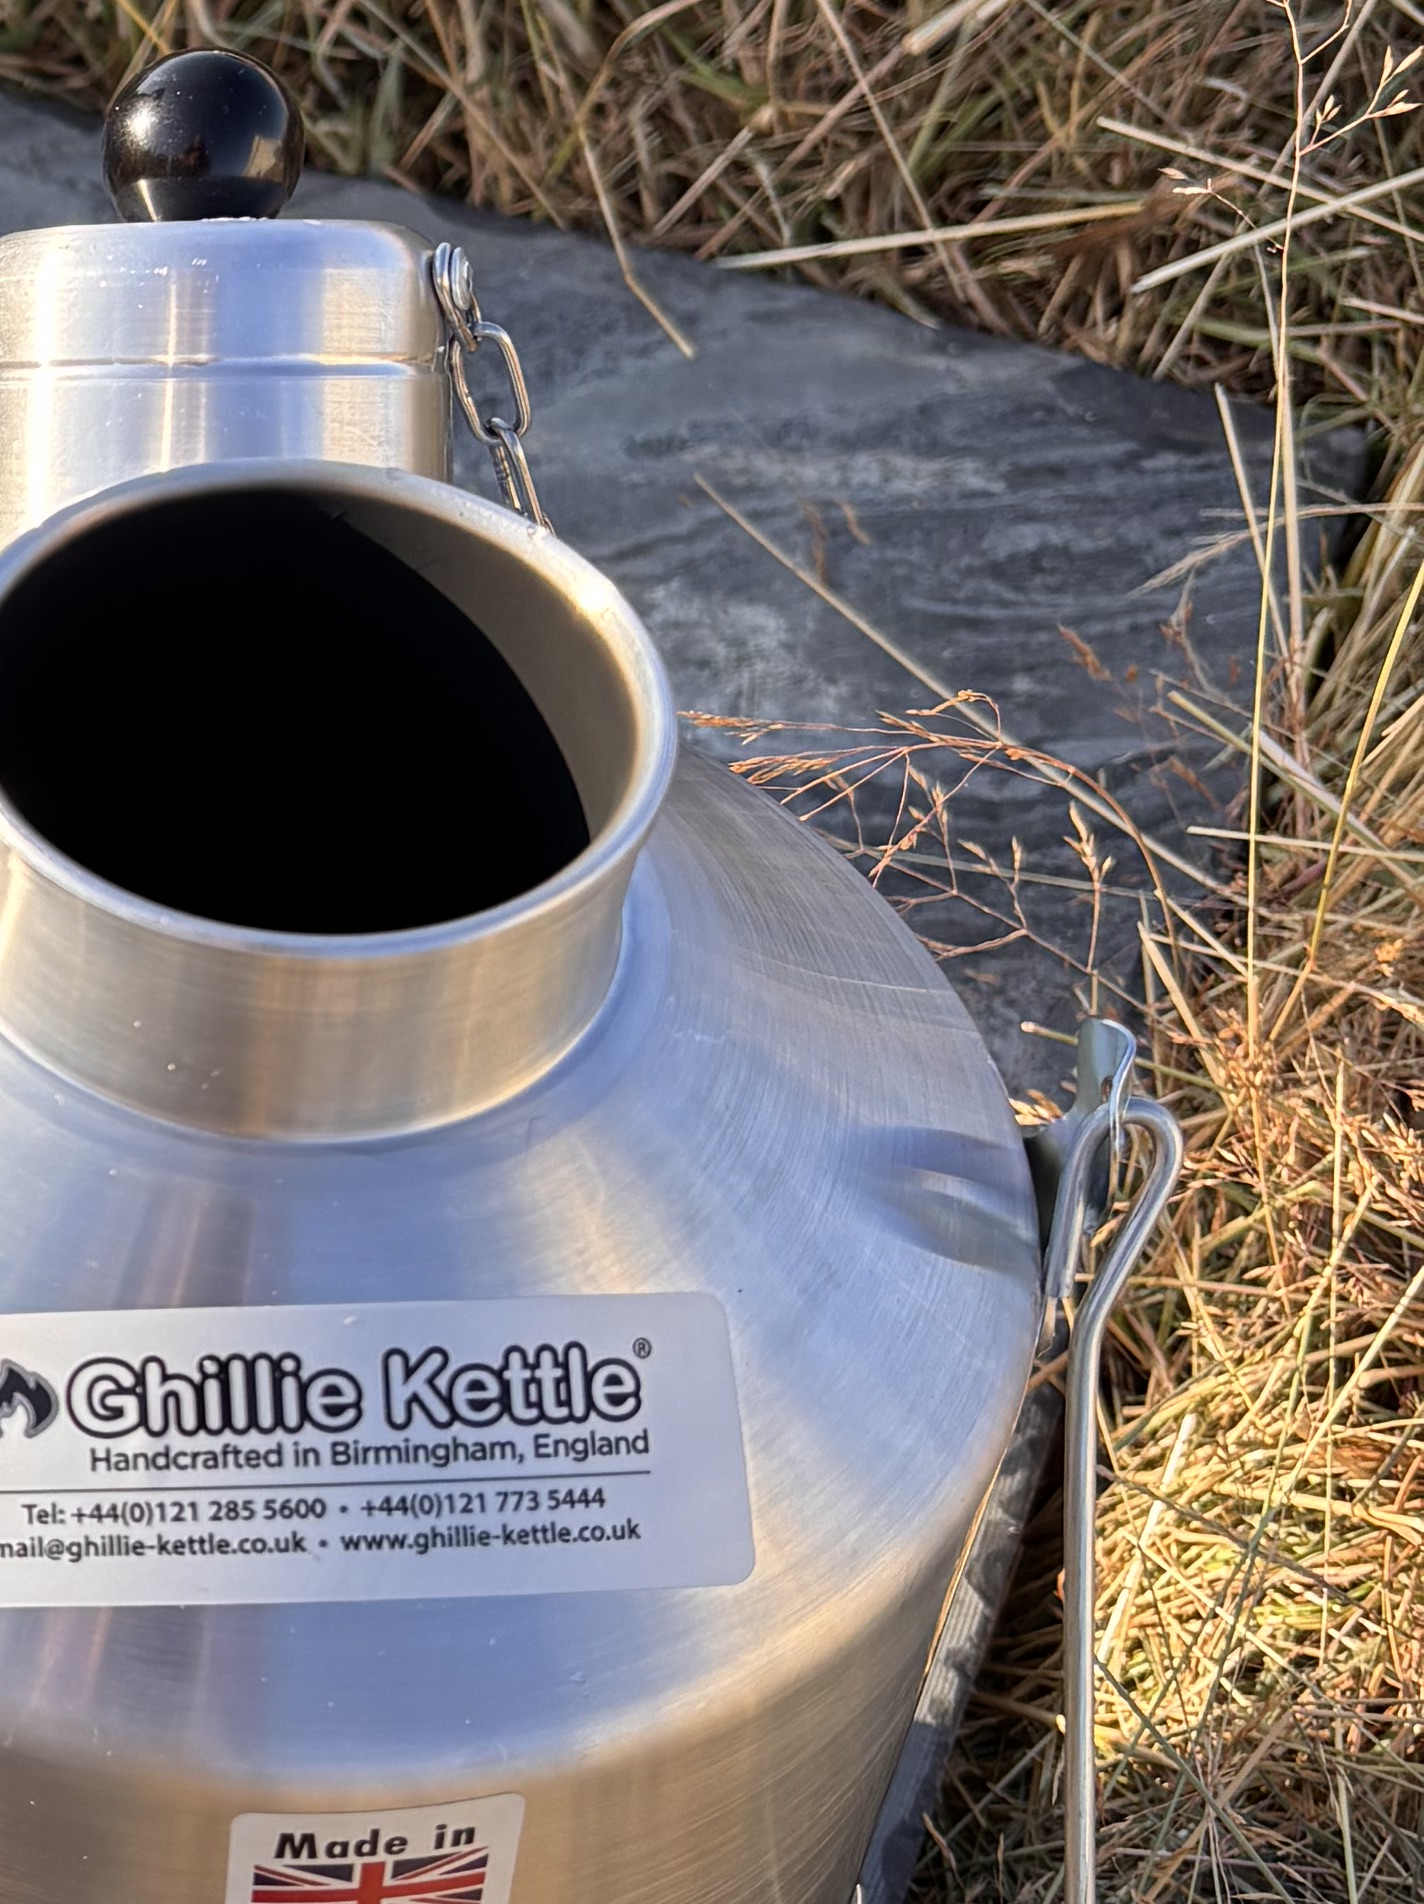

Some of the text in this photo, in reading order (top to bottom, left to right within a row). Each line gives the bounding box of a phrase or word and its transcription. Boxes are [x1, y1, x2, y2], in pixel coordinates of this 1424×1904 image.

[66, 1352, 363, 1439] Ghillie
[89, 1429, 650, 1472] Handcrafted in Birmingham, England
[21, 1487, 605, 1525] Tel: +44(0)121 285 5600 +44(0)121 773 5444
[340, 1518, 642, 1555] www.ghillie-kettle.co.uk
[273, 1824, 477, 1860] Made in
